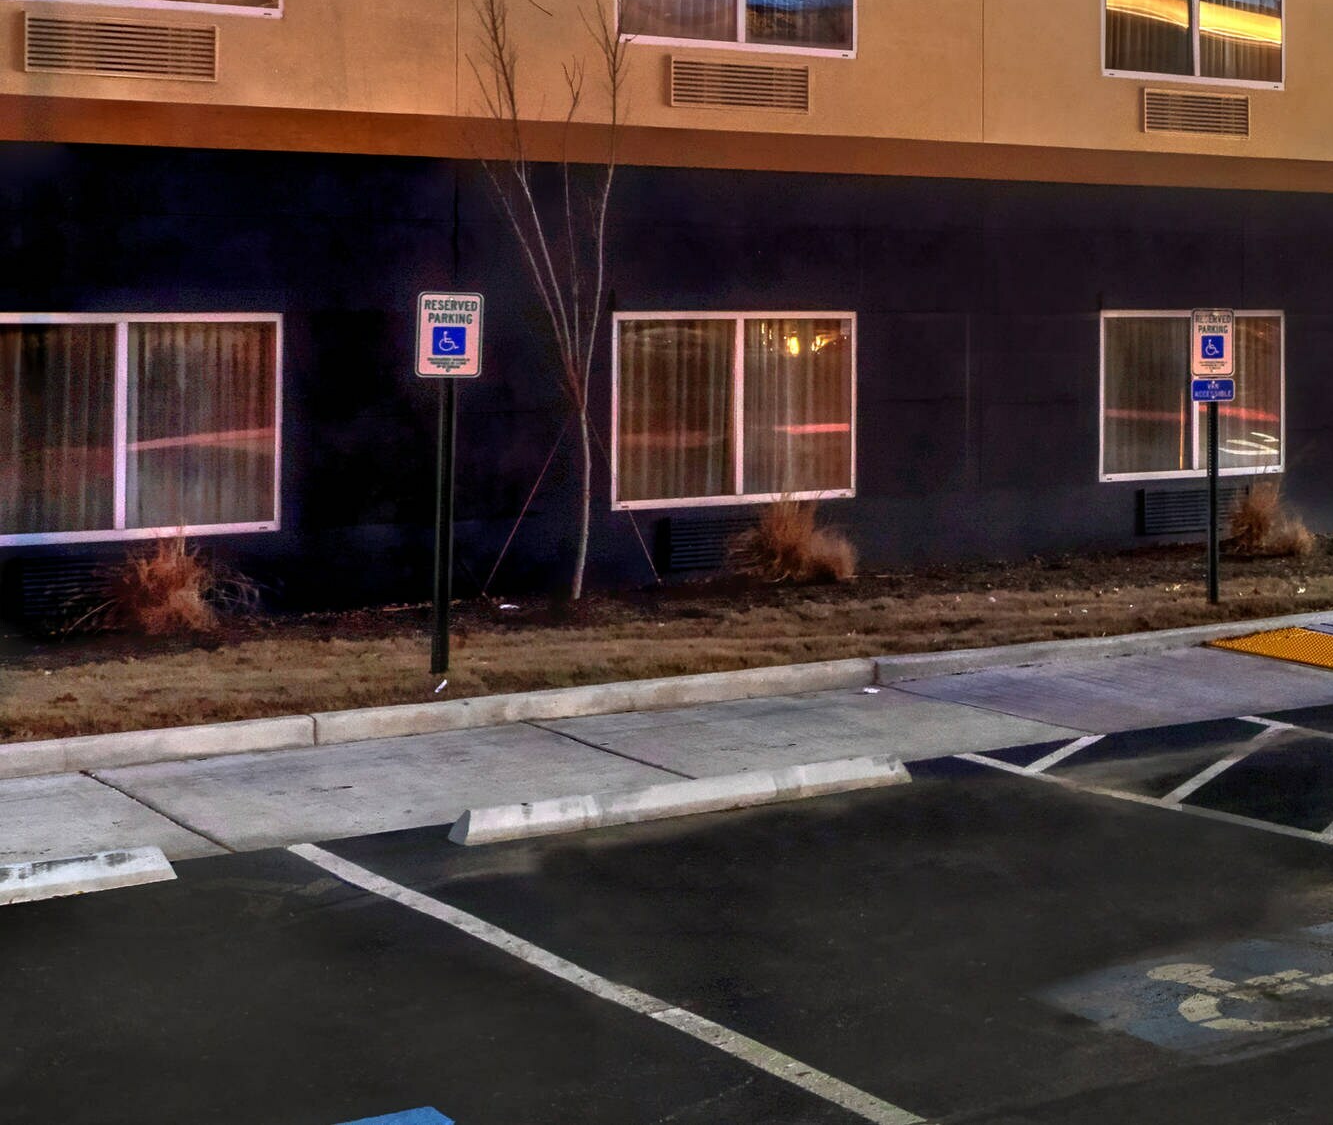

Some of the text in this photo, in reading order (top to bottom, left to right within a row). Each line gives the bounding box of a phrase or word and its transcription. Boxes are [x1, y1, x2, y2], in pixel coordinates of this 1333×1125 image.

[424, 300, 478, 311] RESERVED
[428, 313, 473, 324] PARKING
[1195, 314, 1231, 323] RESERVED
[1198, 324, 1228, 334] PARKING
